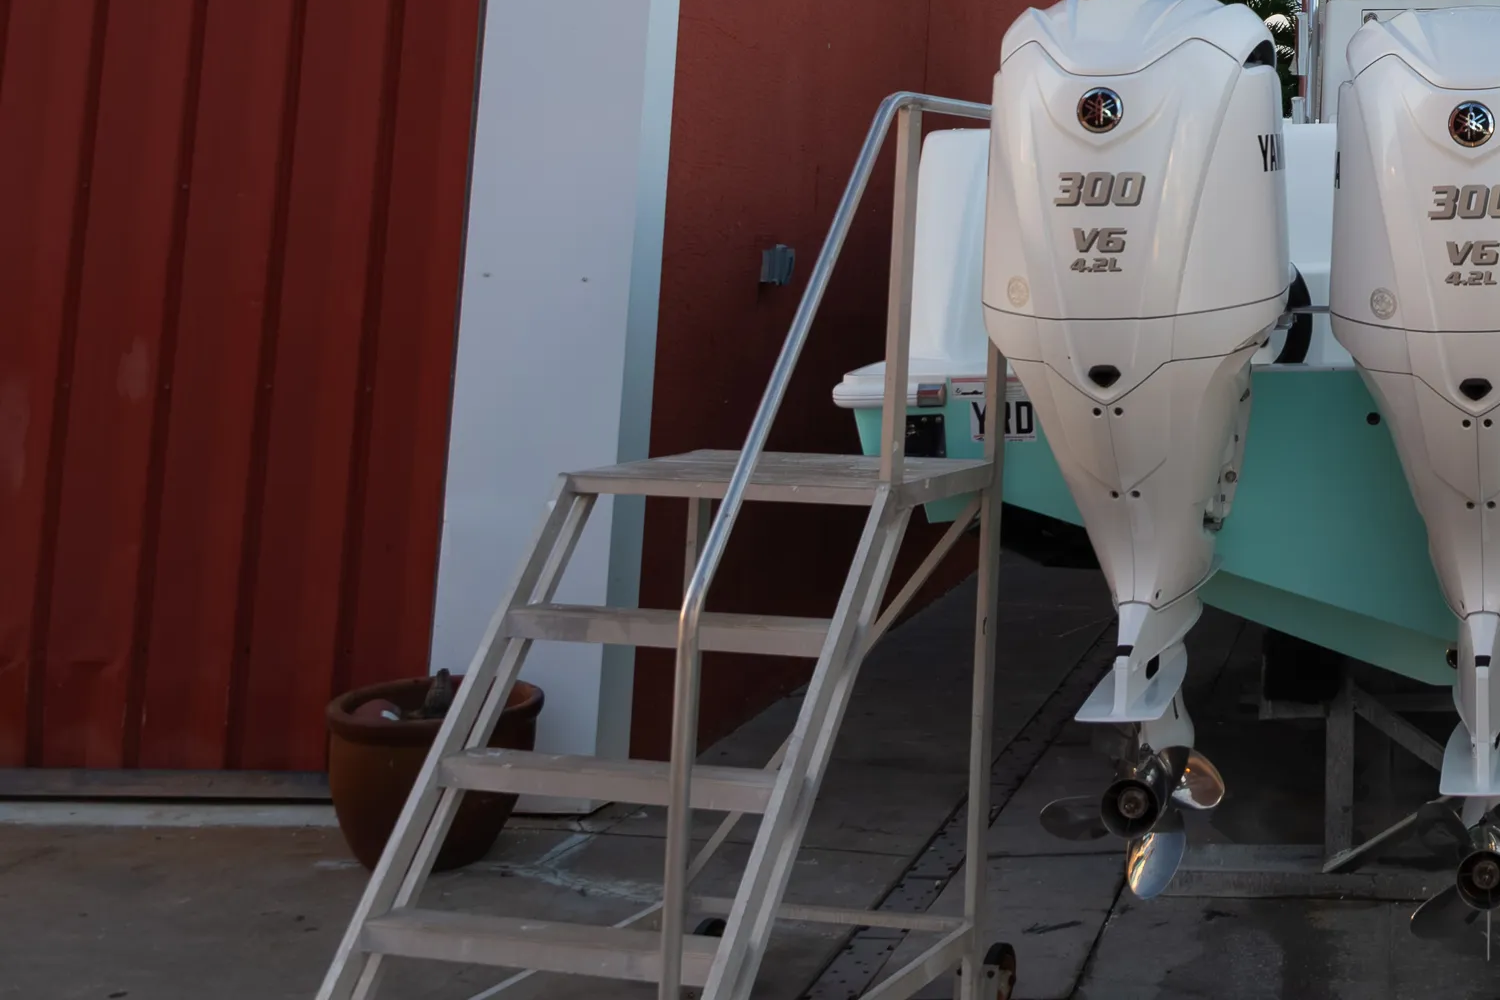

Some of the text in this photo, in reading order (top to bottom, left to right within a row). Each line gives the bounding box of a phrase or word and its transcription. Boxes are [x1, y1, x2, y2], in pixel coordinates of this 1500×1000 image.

[1053, 171, 1147, 207] 300
[1072, 227, 1128, 253] V6
[1446, 240, 1500, 266] V6
[1070, 256, 1123, 273] 4.2L
[1444, 270, 1498, 286] 4.2L
